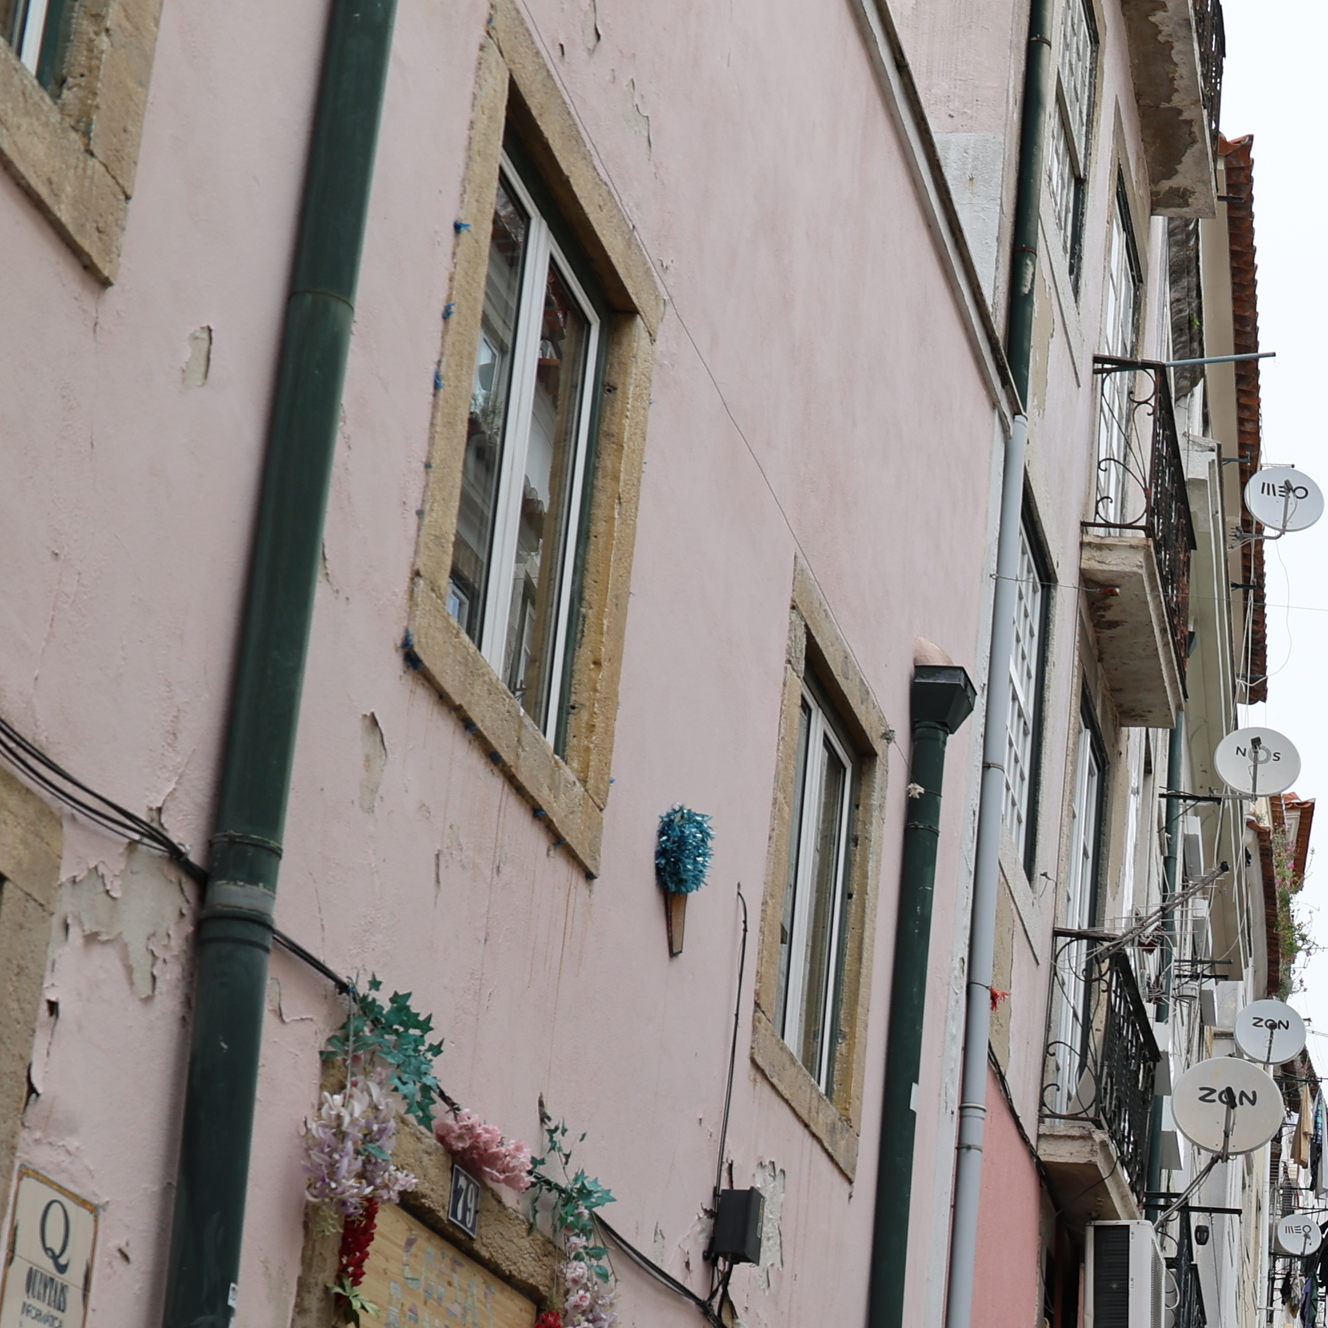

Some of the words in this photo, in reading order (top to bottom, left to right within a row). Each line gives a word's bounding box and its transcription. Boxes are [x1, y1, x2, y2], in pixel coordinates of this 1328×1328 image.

[1236, 746, 1281, 764] NOS
[456, 1175, 475, 1229] 79
[40, 1199, 70, 1275] Q
